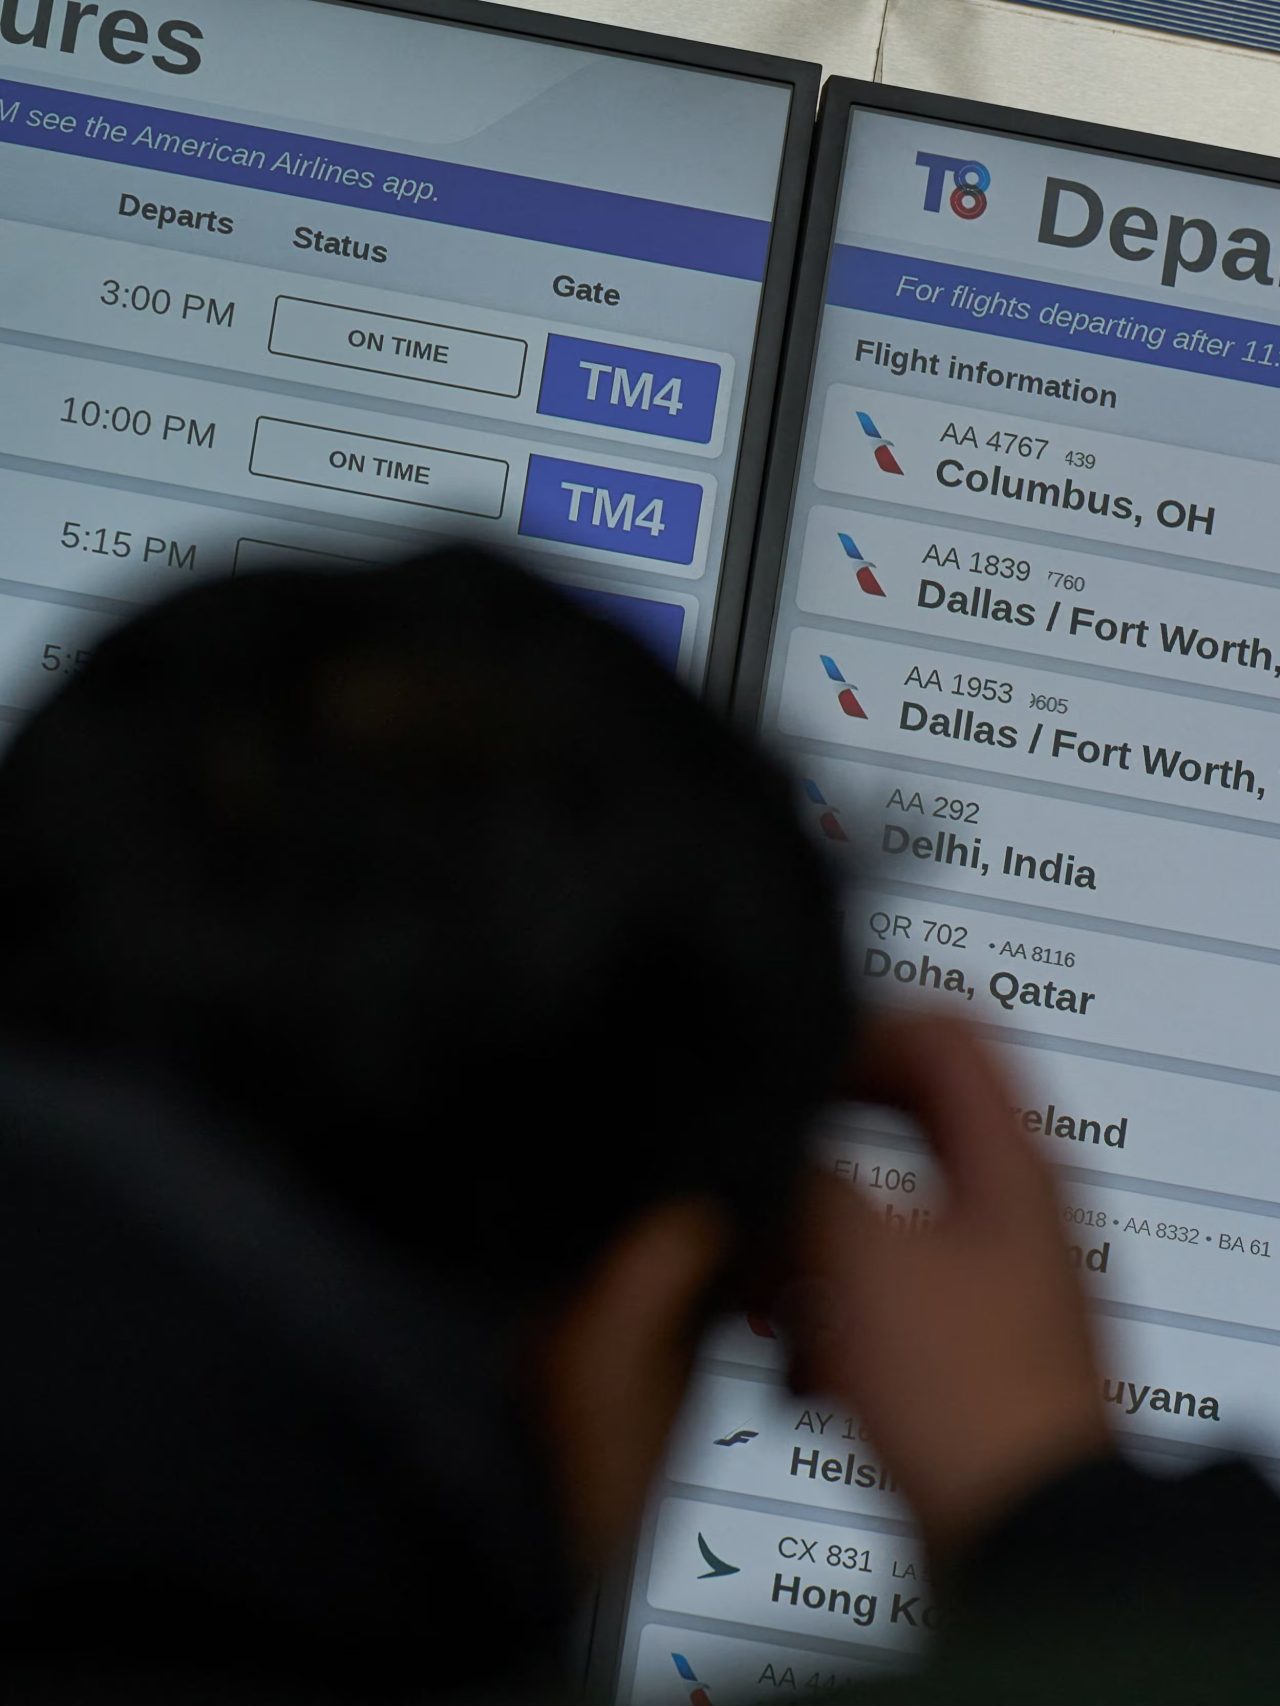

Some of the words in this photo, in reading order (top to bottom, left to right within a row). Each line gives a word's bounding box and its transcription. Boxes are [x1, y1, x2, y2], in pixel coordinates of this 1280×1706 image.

[26, 109, 77, 133] see
[84, 116, 128, 143] the
[131, 126, 266, 169] American
[270, 151, 375, 189] Airlines
[382, 175, 438, 204] app.
[915, 150, 991, 221] T8
[118, 192, 234, 235] Departs
[292, 226, 388, 264] Status
[552, 274, 621, 307] Gate
[100, 279, 171, 315] 3:00
[181, 293, 236, 328] PM
[895, 275, 945, 304] For
[950, 284, 1031, 320] flights
[1038, 302, 1167, 351] departing
[1172, 329, 1236, 358] after
[579, 360, 684, 416] TM4
[855, 339, 940, 377] Flight
[948, 355, 1117, 409] information
[60, 396, 152, 436] 10:00
[162, 414, 216, 449] PM
[939, 422, 979, 449] AA
[985, 431, 1049, 460] 4767
[1064, 449, 1097, 470] 439
[560, 481, 666, 537] TM4
[935, 458, 1143, 528] Columbus,
[1156, 499, 1216, 536] OH
[60, 521, 132, 558] 5:15
[143, 536, 197, 571] PM
[921, 543, 961, 570] AA
[968, 551, 1031, 582] 1839
[917, 578, 1036, 627] Dallas
[1069, 606, 1150, 649] Fort
[903, 665, 943, 693] AA
[951, 673, 1014, 704] 1953
[899, 700, 1018, 749] Dallas
[1051, 728, 1132, 771] Fort
[1142, 744, 1265, 801] Worth,
[885, 788, 925, 815] AA
[932, 796, 980, 825] 292
[881, 824, 989, 877] Delhi,
[1002, 845, 1097, 891] India
[868, 911, 913, 941] QR
[923, 920, 968, 949] 702
[999, 940, 1027, 960] AA
[1031, 946, 1076, 968] 8116
[862, 947, 976, 1002] Doha,
[989, 971, 1096, 1016] Qatar
[868, 1164, 918, 1195] 106
[1124, 1217, 1151, 1236] AA
[1155, 1222, 1200, 1245] 8332
[1218, 1233, 1245, 1253] BA
[1249, 1239, 1271, 1258] 61
[777, 1536, 818, 1563] CX
[826, 1544, 872, 1573] 831
[771, 1572, 877, 1626] Hong
